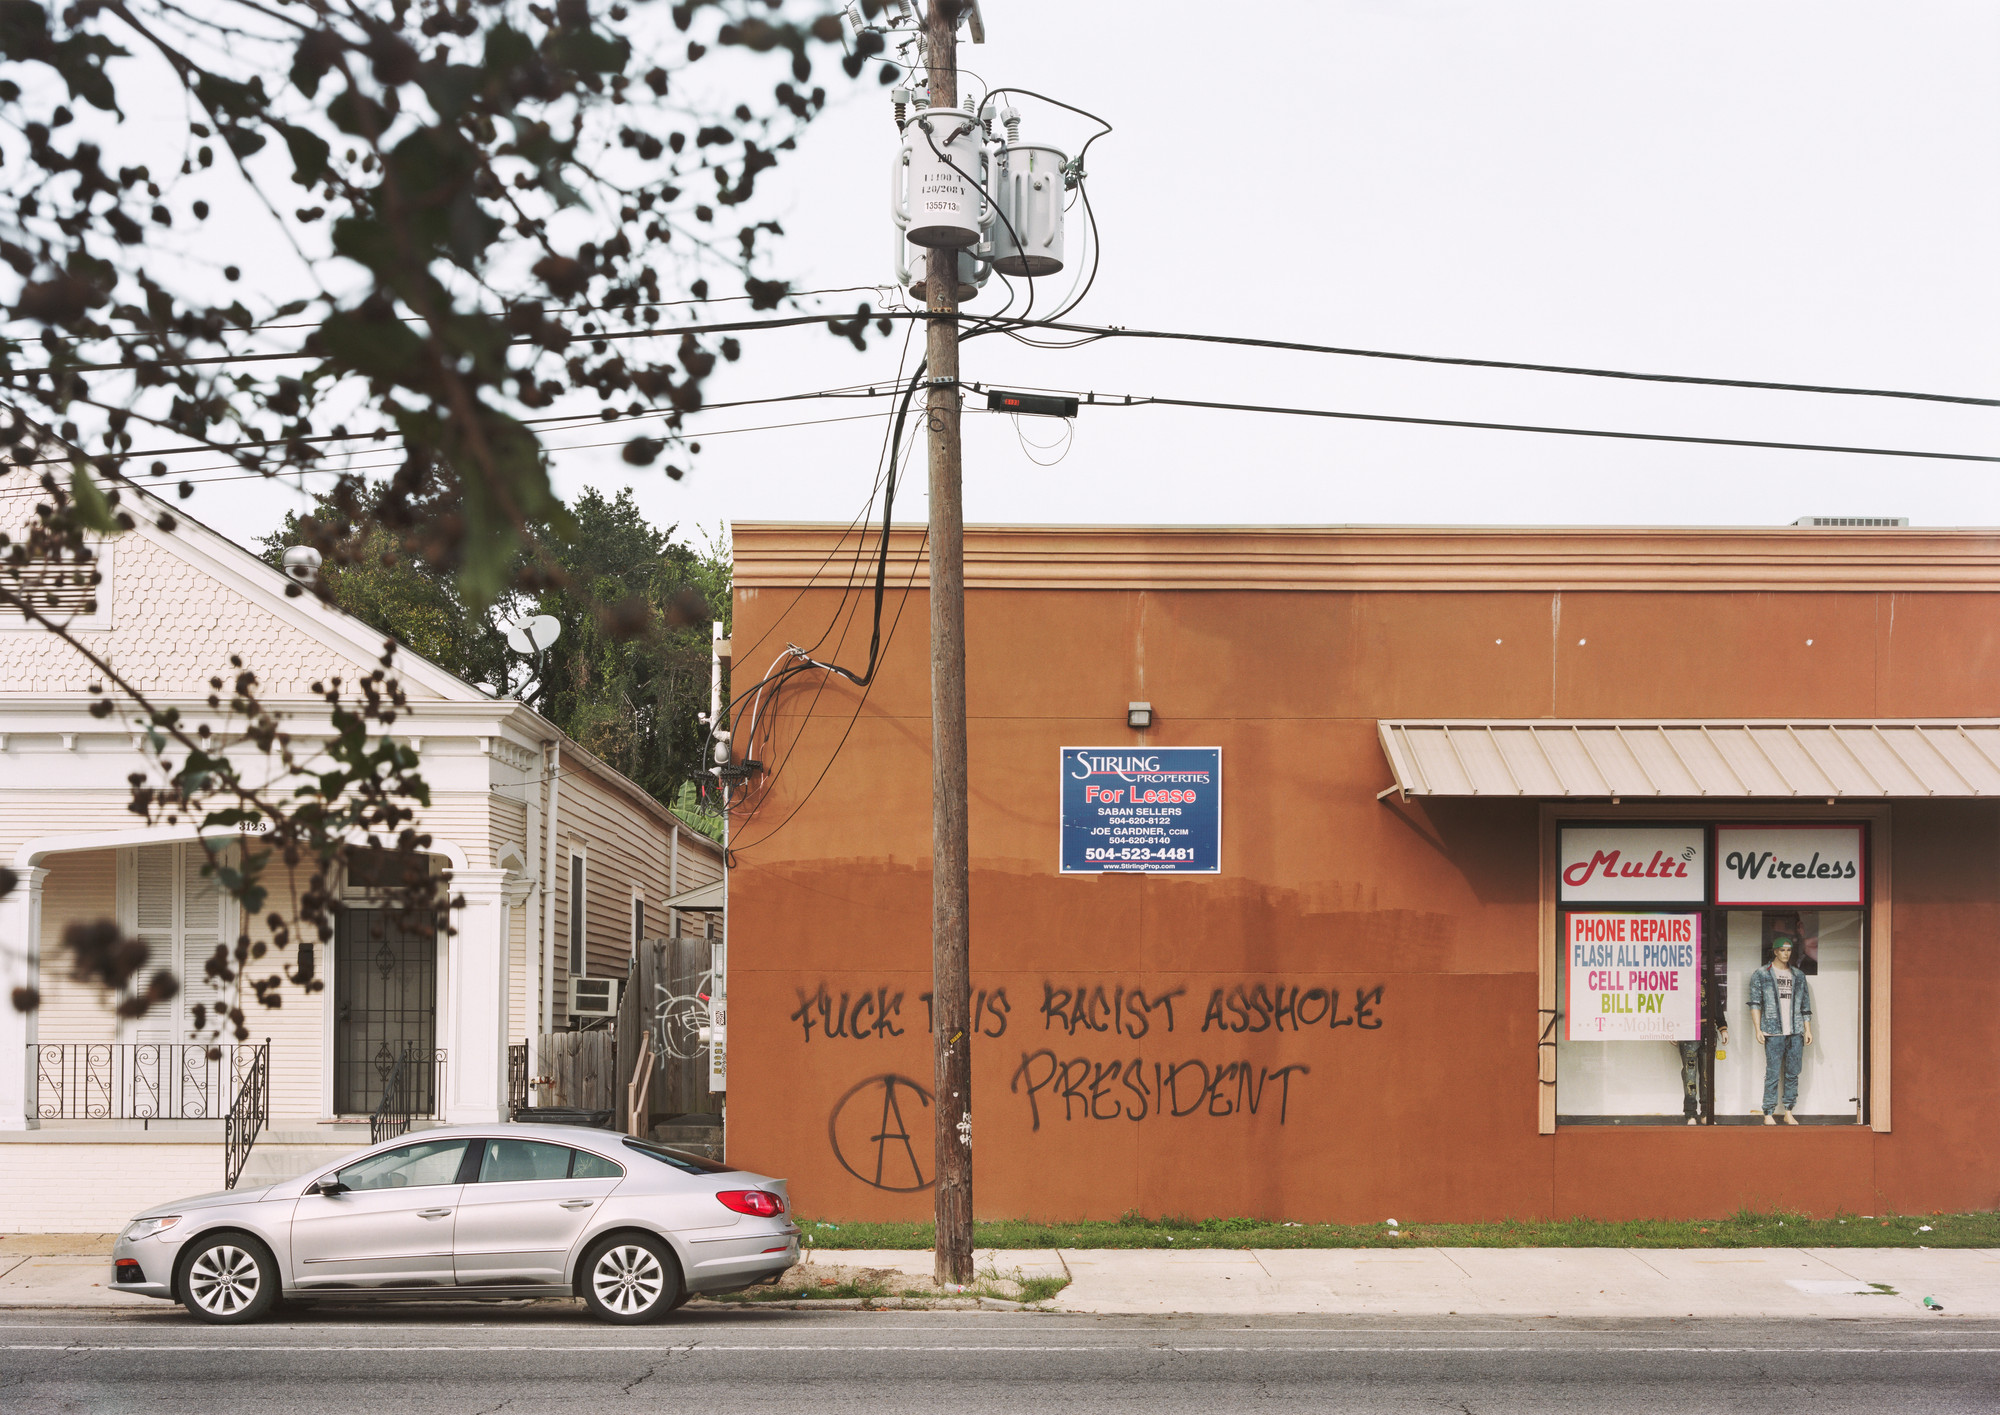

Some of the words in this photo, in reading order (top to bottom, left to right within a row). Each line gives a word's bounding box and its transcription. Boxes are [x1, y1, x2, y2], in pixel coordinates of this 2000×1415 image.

[1137, 774, 1210, 784] PROPERTIES
[1085, 785, 1124, 803] For
[1130, 785, 1196, 804] Lease
[1098, 808, 1133, 816] SABAN
[1135, 808, 1182, 816] SELLERS
[1109, 817, 1171, 825] 504-620-8122
[239, 822, 267, 832] 3123
[1090, 828, 1111, 836] JOE
[1113, 828, 1167, 837] GARDNER,
[1109, 837, 1170, 845] 504-620-8140
[1085, 848, 1195, 860] 504-523-4481
[1563, 850, 1688, 887] Multi
[1726, 851, 1856, 880] Wireless
[1575, 919, 1626, 942] PHONE
[1630, 919, 1691, 942] REPAIRS
[1574, 944, 1613, 967] FLASH
[1616, 944, 1640, 967] ALL
[1643, 944, 1693, 967] PHONES
[1588, 970, 1624, 991] CELL
[1628, 970, 1679, 991] PHONE
[791, 981, 904, 1043] FUCK
[919, 986, 1011, 1038] TIS
[1040, 981, 1187, 1039] RACIST
[1201, 982, 1385, 1033] ASSHOLE
[1601, 993, 1633, 1013] BILL
[1637, 993, 1665, 1013] PAY
[1011, 1048, 1310, 1132] PRESIDENT
